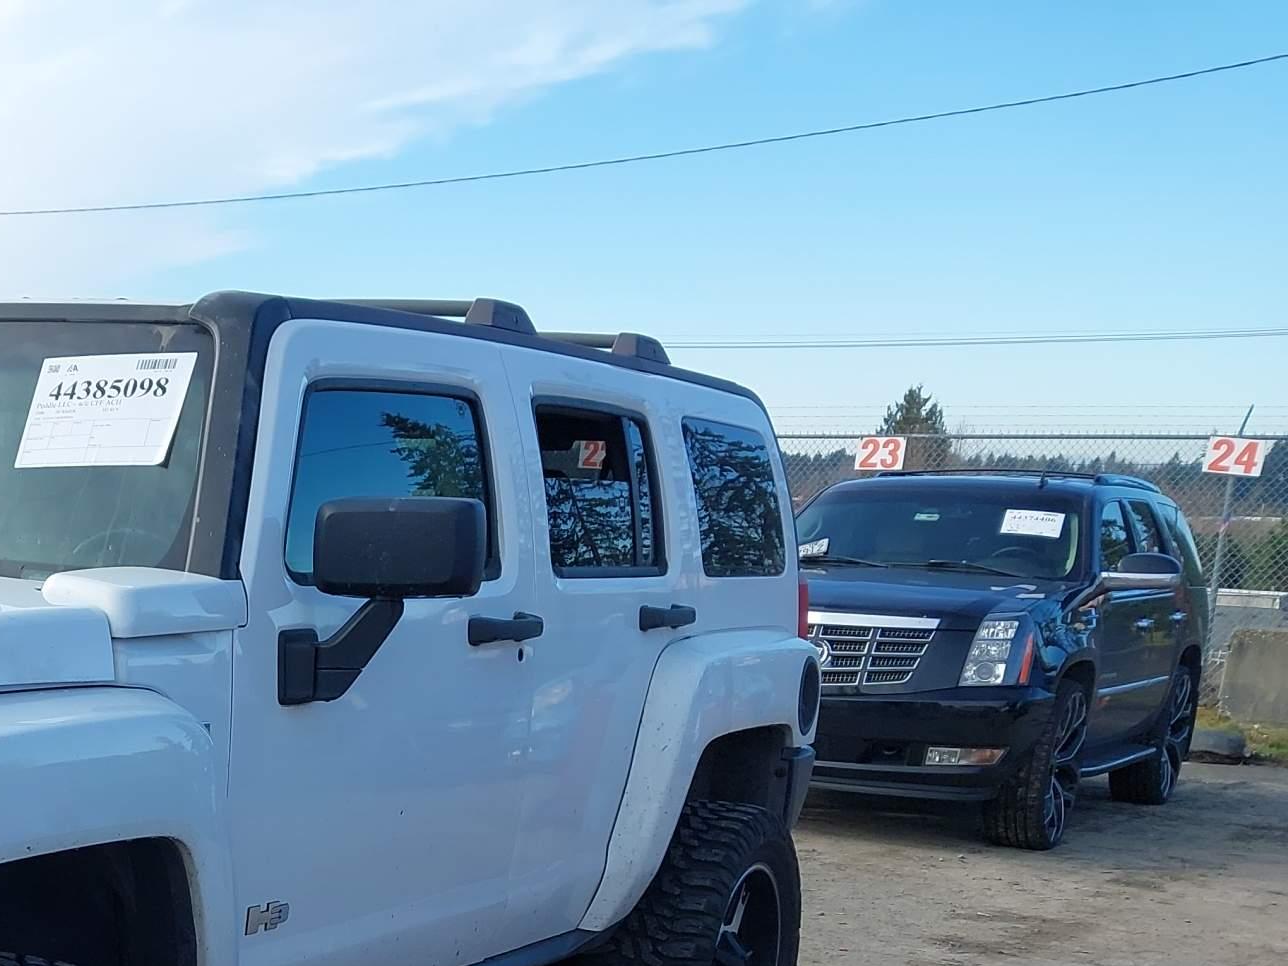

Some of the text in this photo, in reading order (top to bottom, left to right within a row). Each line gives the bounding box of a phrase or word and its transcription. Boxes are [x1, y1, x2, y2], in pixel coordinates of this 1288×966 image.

[49, 377, 169, 400] 44385098
[859, 439, 901, 468] 23
[1208, 439, 1259, 474] 24
[244, 900, 290, 937] H3
